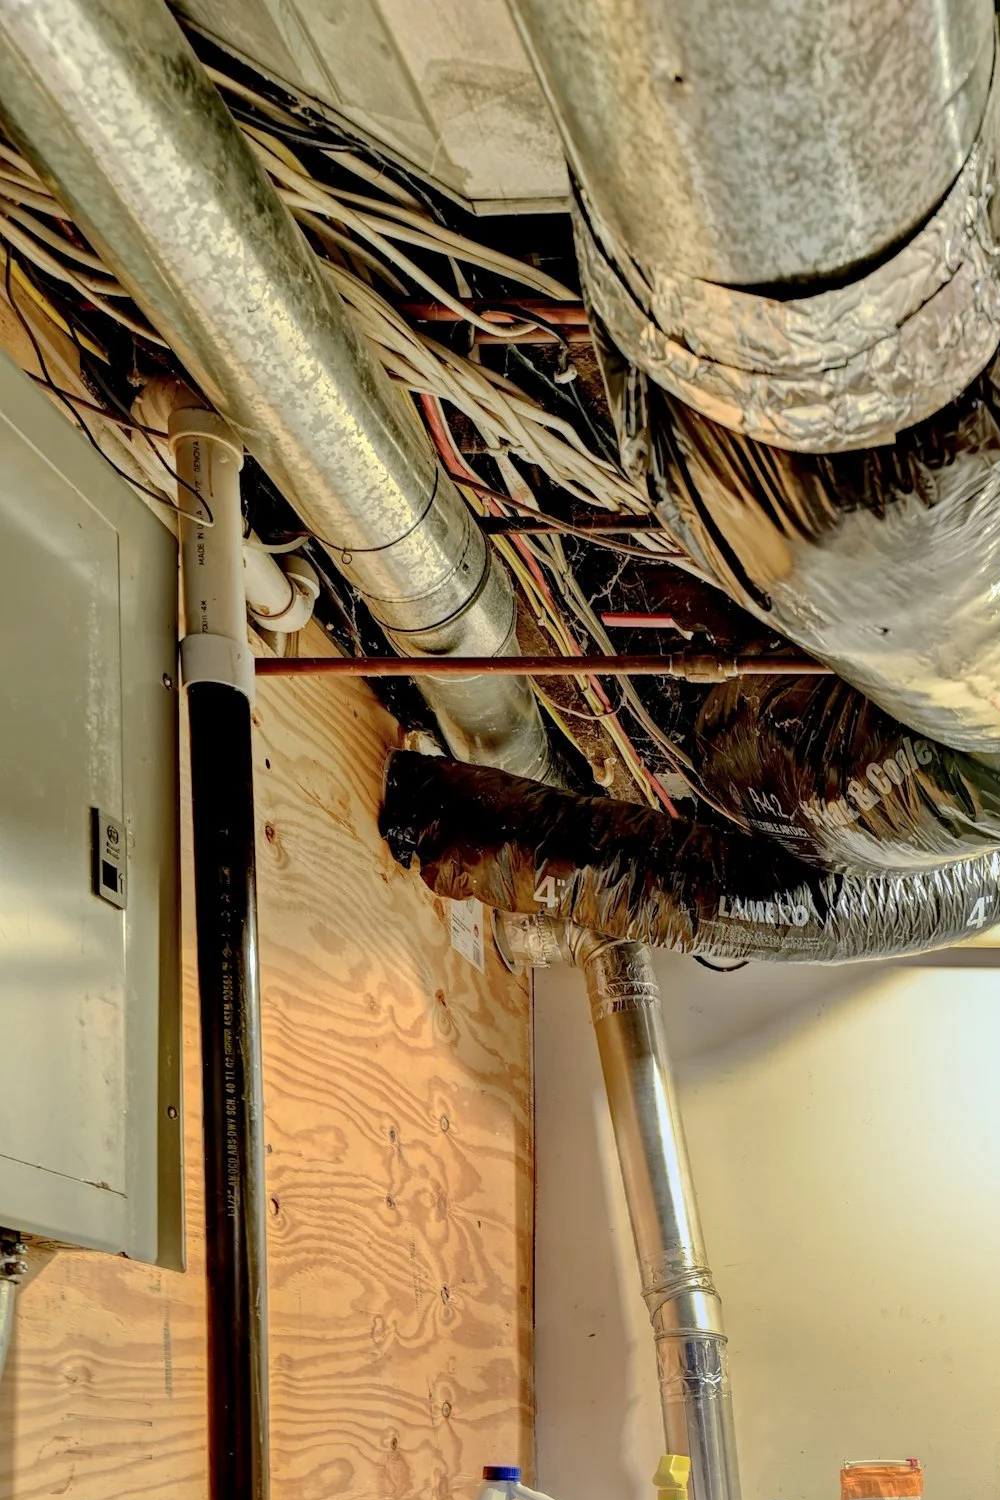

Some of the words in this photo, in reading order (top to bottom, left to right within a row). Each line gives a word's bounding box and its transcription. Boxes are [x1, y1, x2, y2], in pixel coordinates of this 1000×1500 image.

[966, 895, 993, 929] 4"
[226, 1083, 235, 1093] 40
[226, 1097, 236, 1115] SCH.
[227, 1118, 237, 1155] ABS-DWV
[228, 1158, 238, 1186] AMOCO
